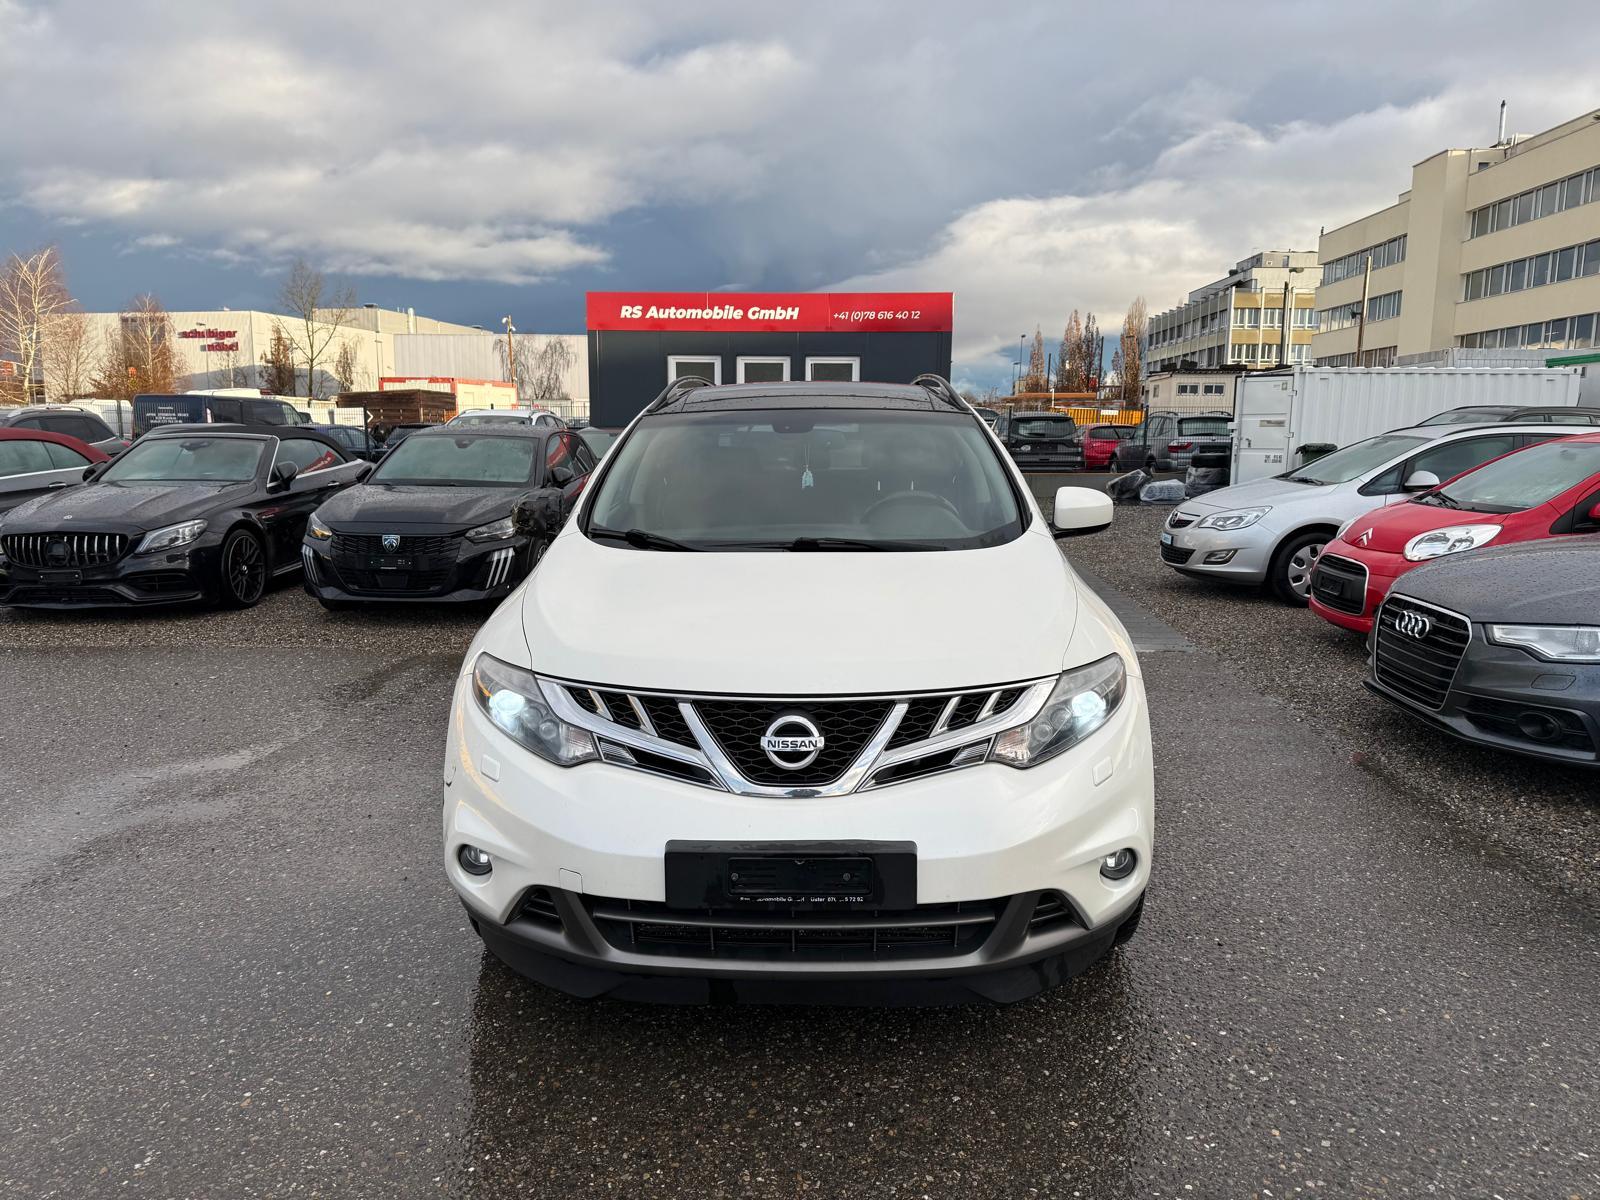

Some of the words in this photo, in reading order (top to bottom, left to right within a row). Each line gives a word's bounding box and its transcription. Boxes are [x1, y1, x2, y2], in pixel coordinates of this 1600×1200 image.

[620, 305, 643, 319] RS
[645, 305, 744, 320] Automobile
[747, 306, 799, 320] GmbH
[833, 311, 849, 320] +41
[850, 311, 876, 323] (0)78
[877, 311, 894, 320] 616
[895, 311, 909, 320] 40
[911, 310, 921, 319] 12
[767, 739, 818, 750] NISSAN
